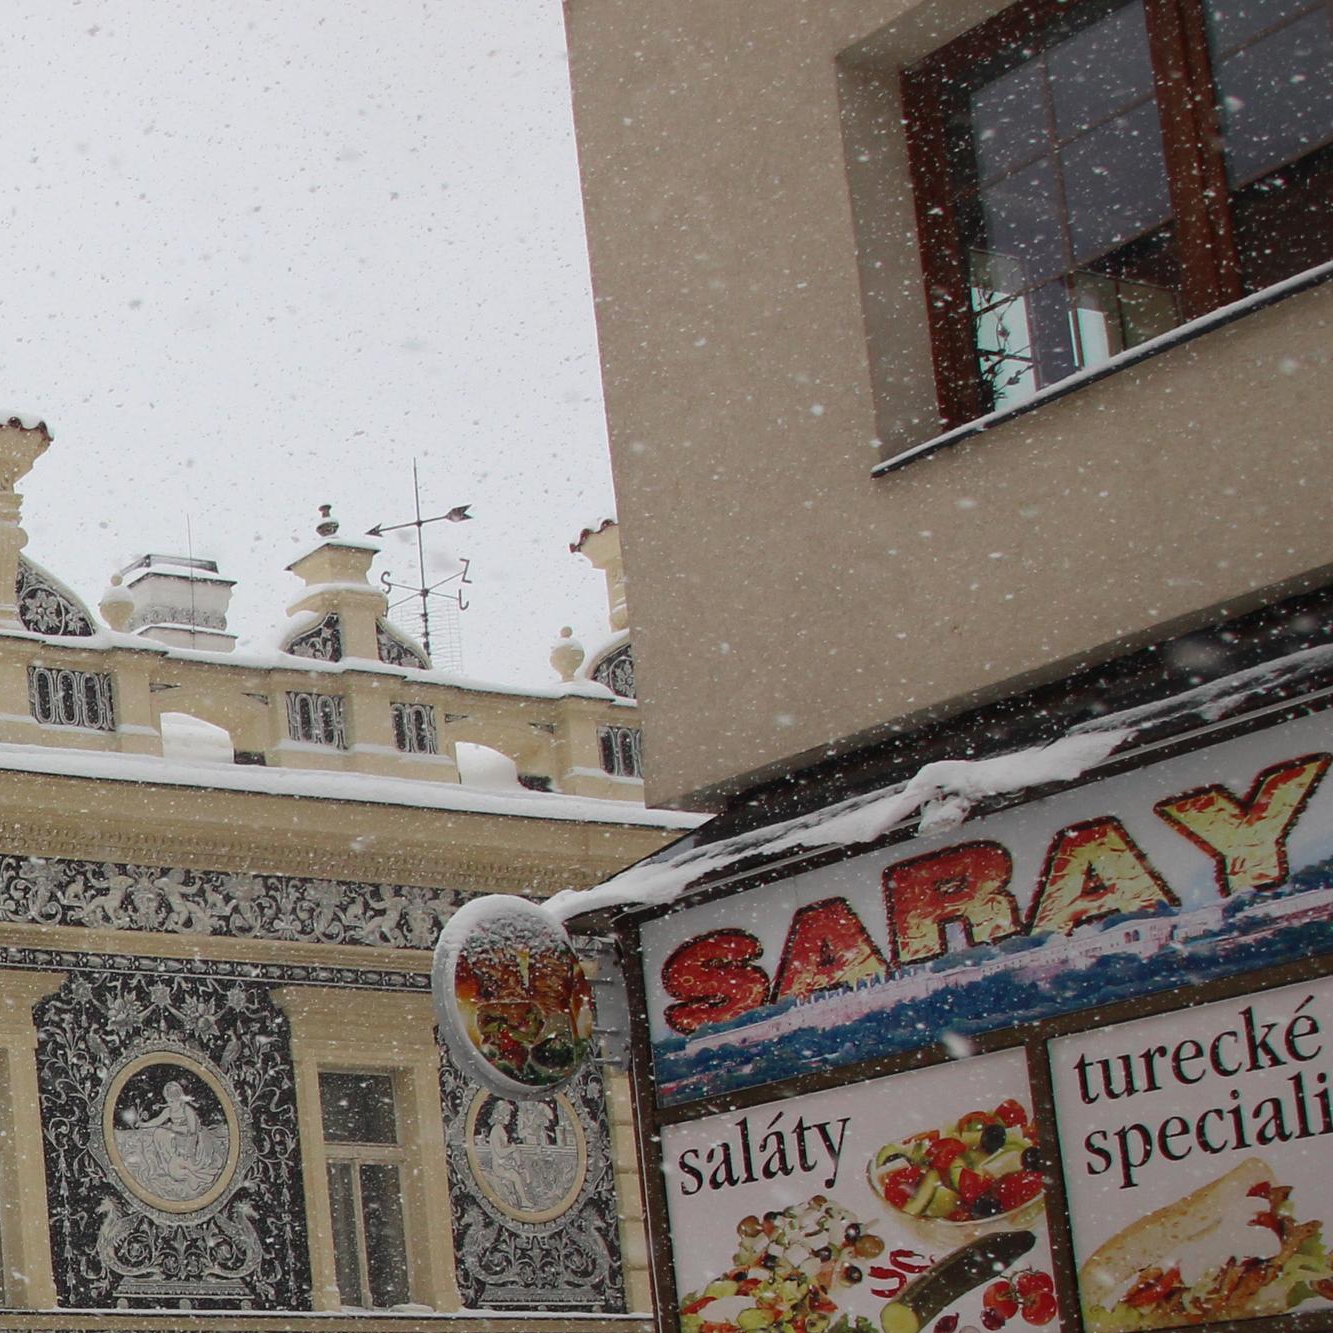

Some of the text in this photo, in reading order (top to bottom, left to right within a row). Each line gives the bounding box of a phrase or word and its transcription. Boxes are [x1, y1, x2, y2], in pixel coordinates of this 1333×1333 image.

[662, 751, 1332, 1036] SARAY
[1073, 995, 1322, 1104] turecké
[679, 1112, 851, 1195] saláty
[1084, 1071, 1333, 1189] speciali
